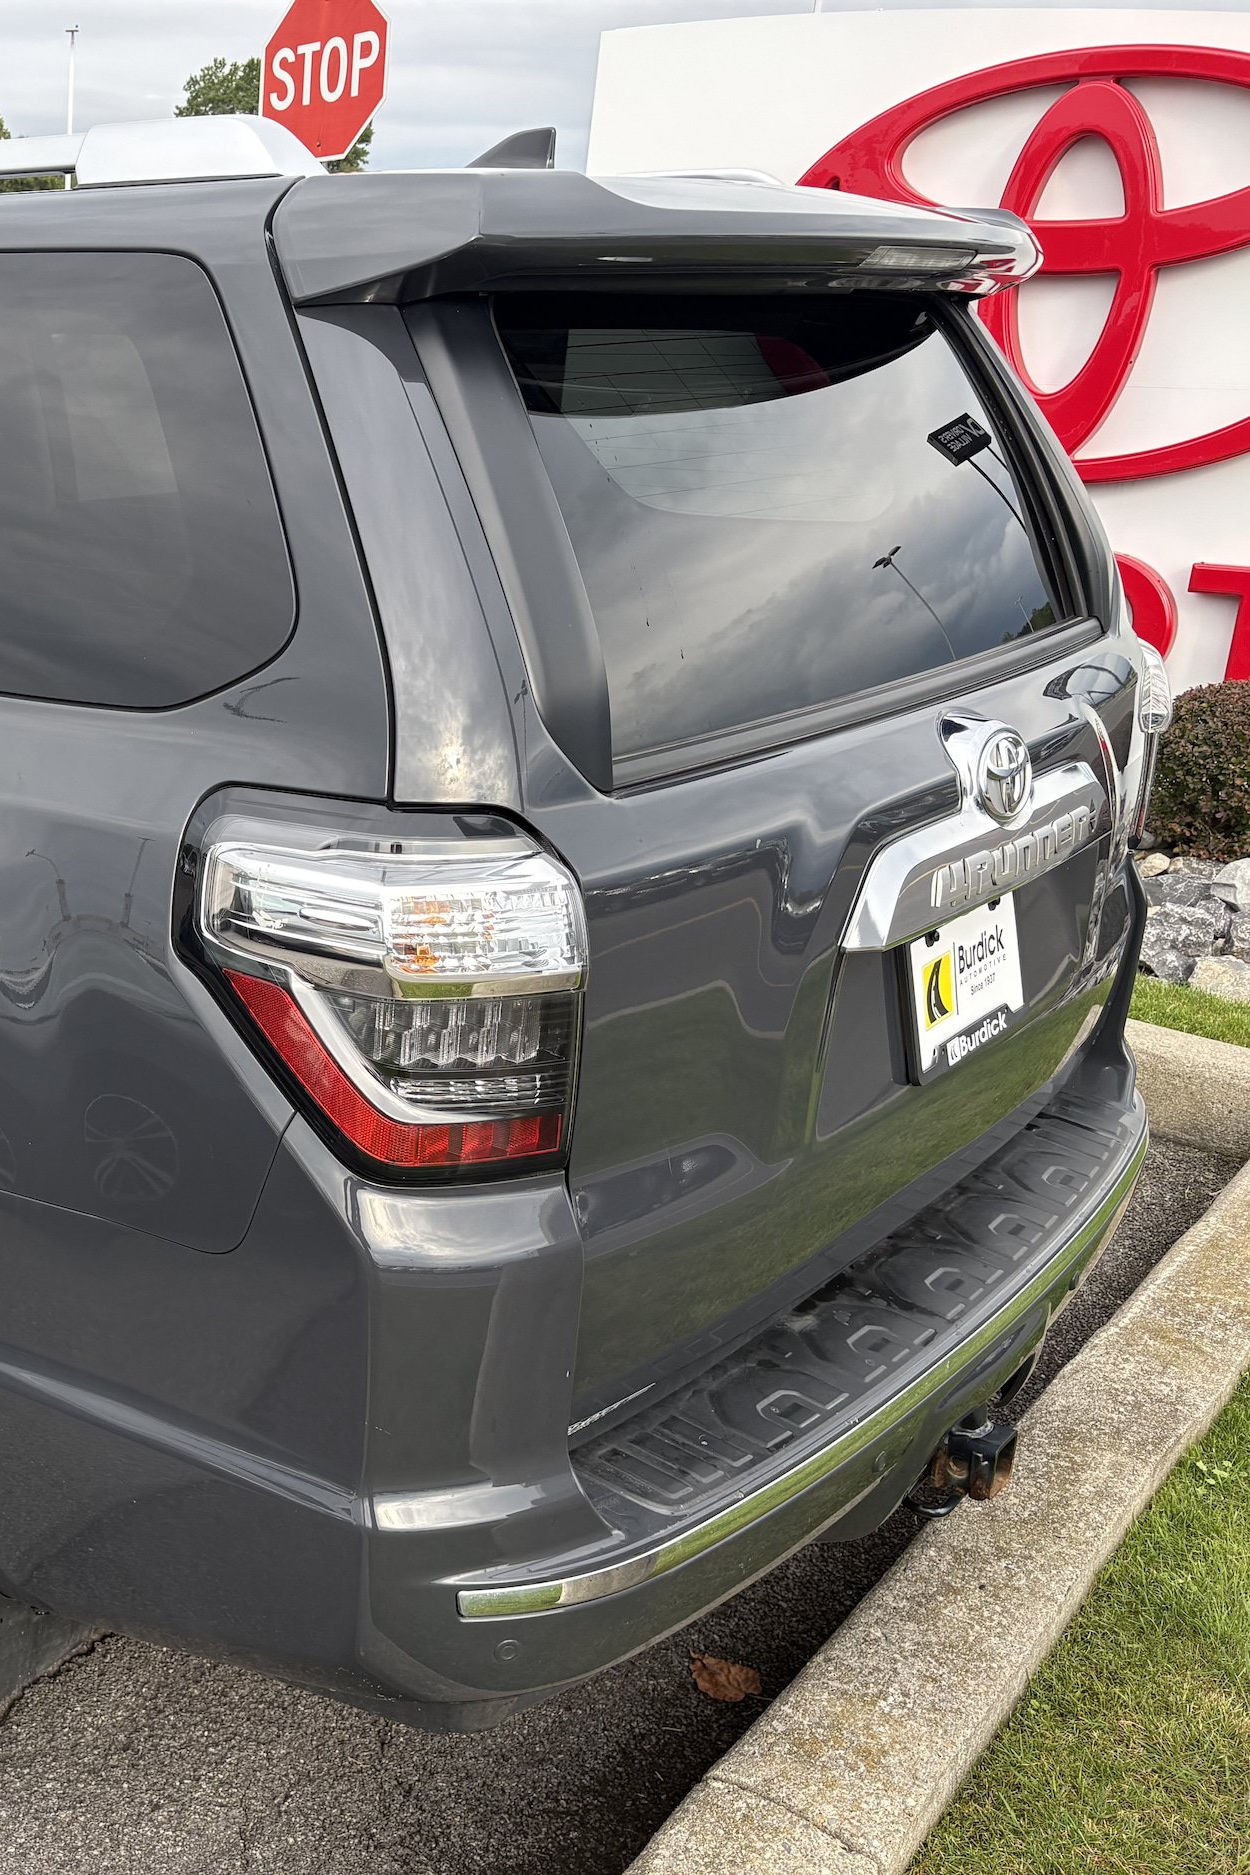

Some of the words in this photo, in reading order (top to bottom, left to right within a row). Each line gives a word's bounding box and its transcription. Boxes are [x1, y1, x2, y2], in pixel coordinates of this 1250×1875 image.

[269, 30, 380, 111] STOP
[930, 805, 1097, 908] 4RUNNER
[958, 924, 1005, 974] Burdick
[960, 953, 1007, 986] AUTOMOTIVE
[970, 982, 984, 996] Since
[958, 1011, 1008, 1058] Burdick
